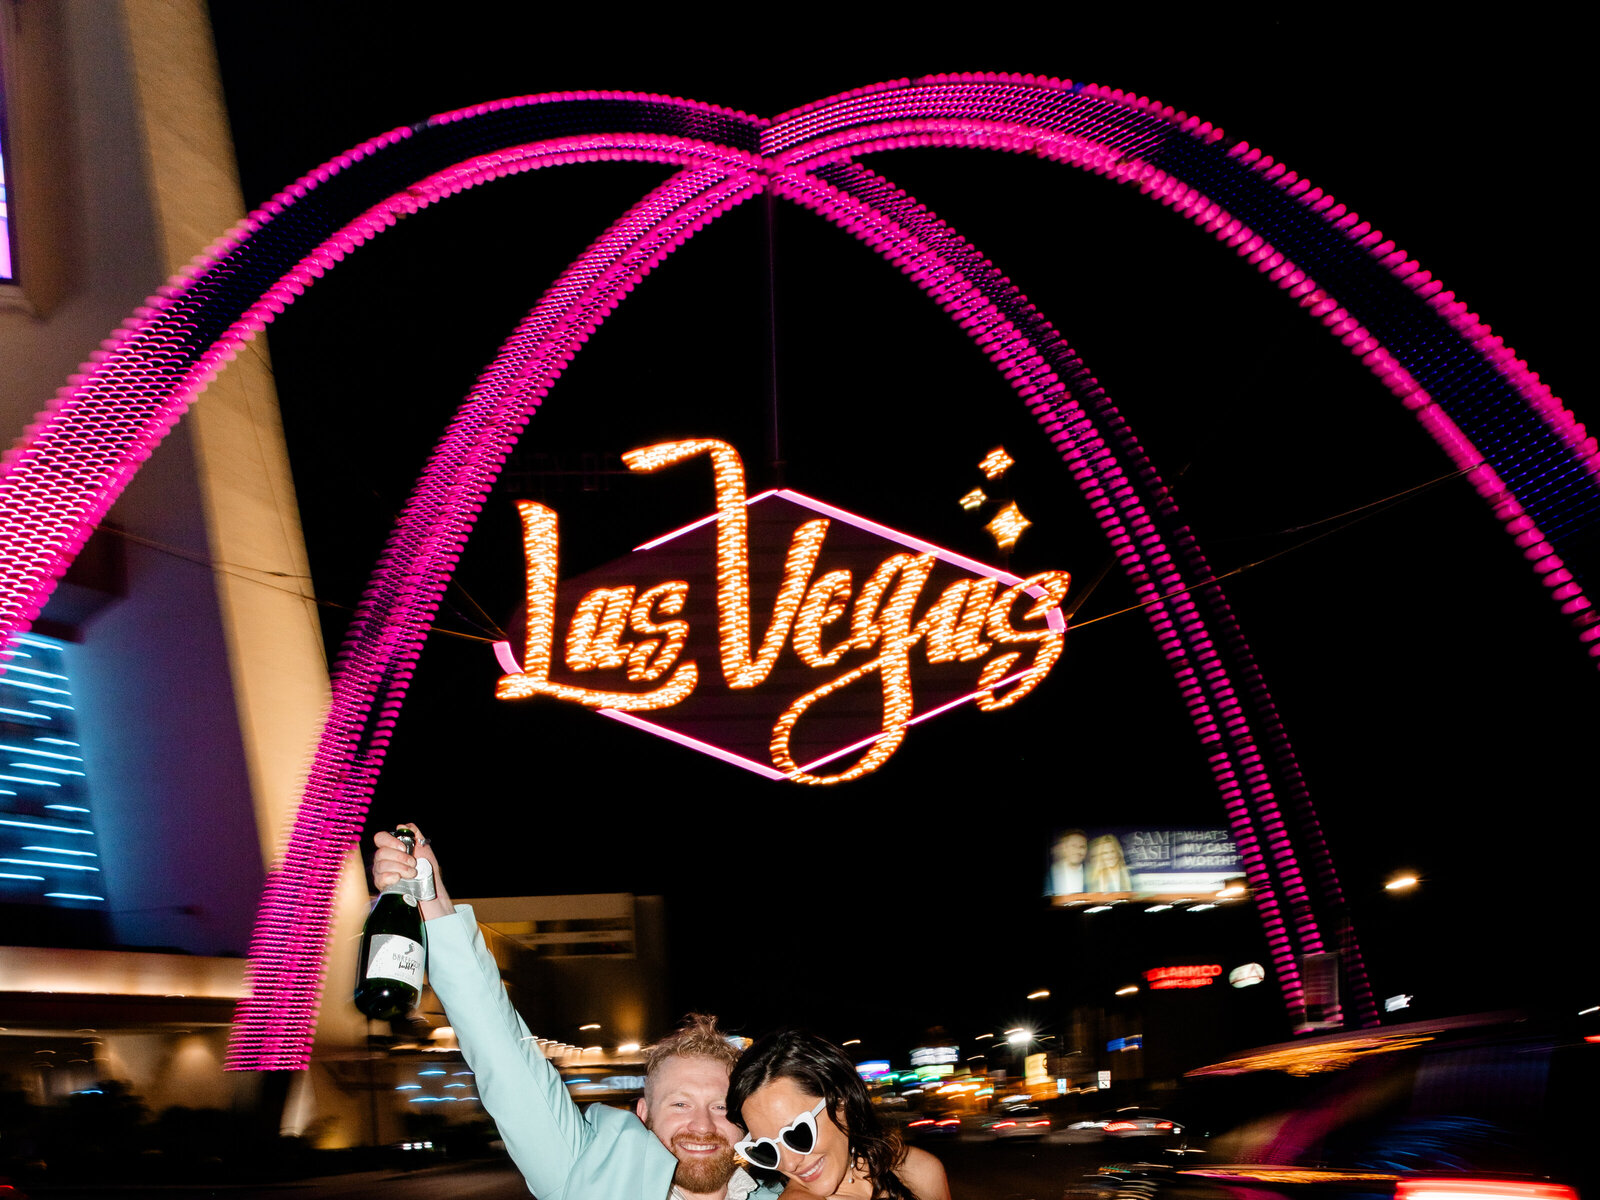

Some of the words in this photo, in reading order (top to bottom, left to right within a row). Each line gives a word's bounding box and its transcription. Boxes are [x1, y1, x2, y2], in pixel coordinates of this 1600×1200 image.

[494, 500, 698, 712] Las
[621, 438, 1071, 785] Vegas
[1133, 831, 1170, 845] SAM
[1136, 845, 1170, 860] ASH
[1183, 843, 1203, 853] MY
[1206, 842, 1237, 853] CASE
[611, 1075, 646, 1089] STRA
